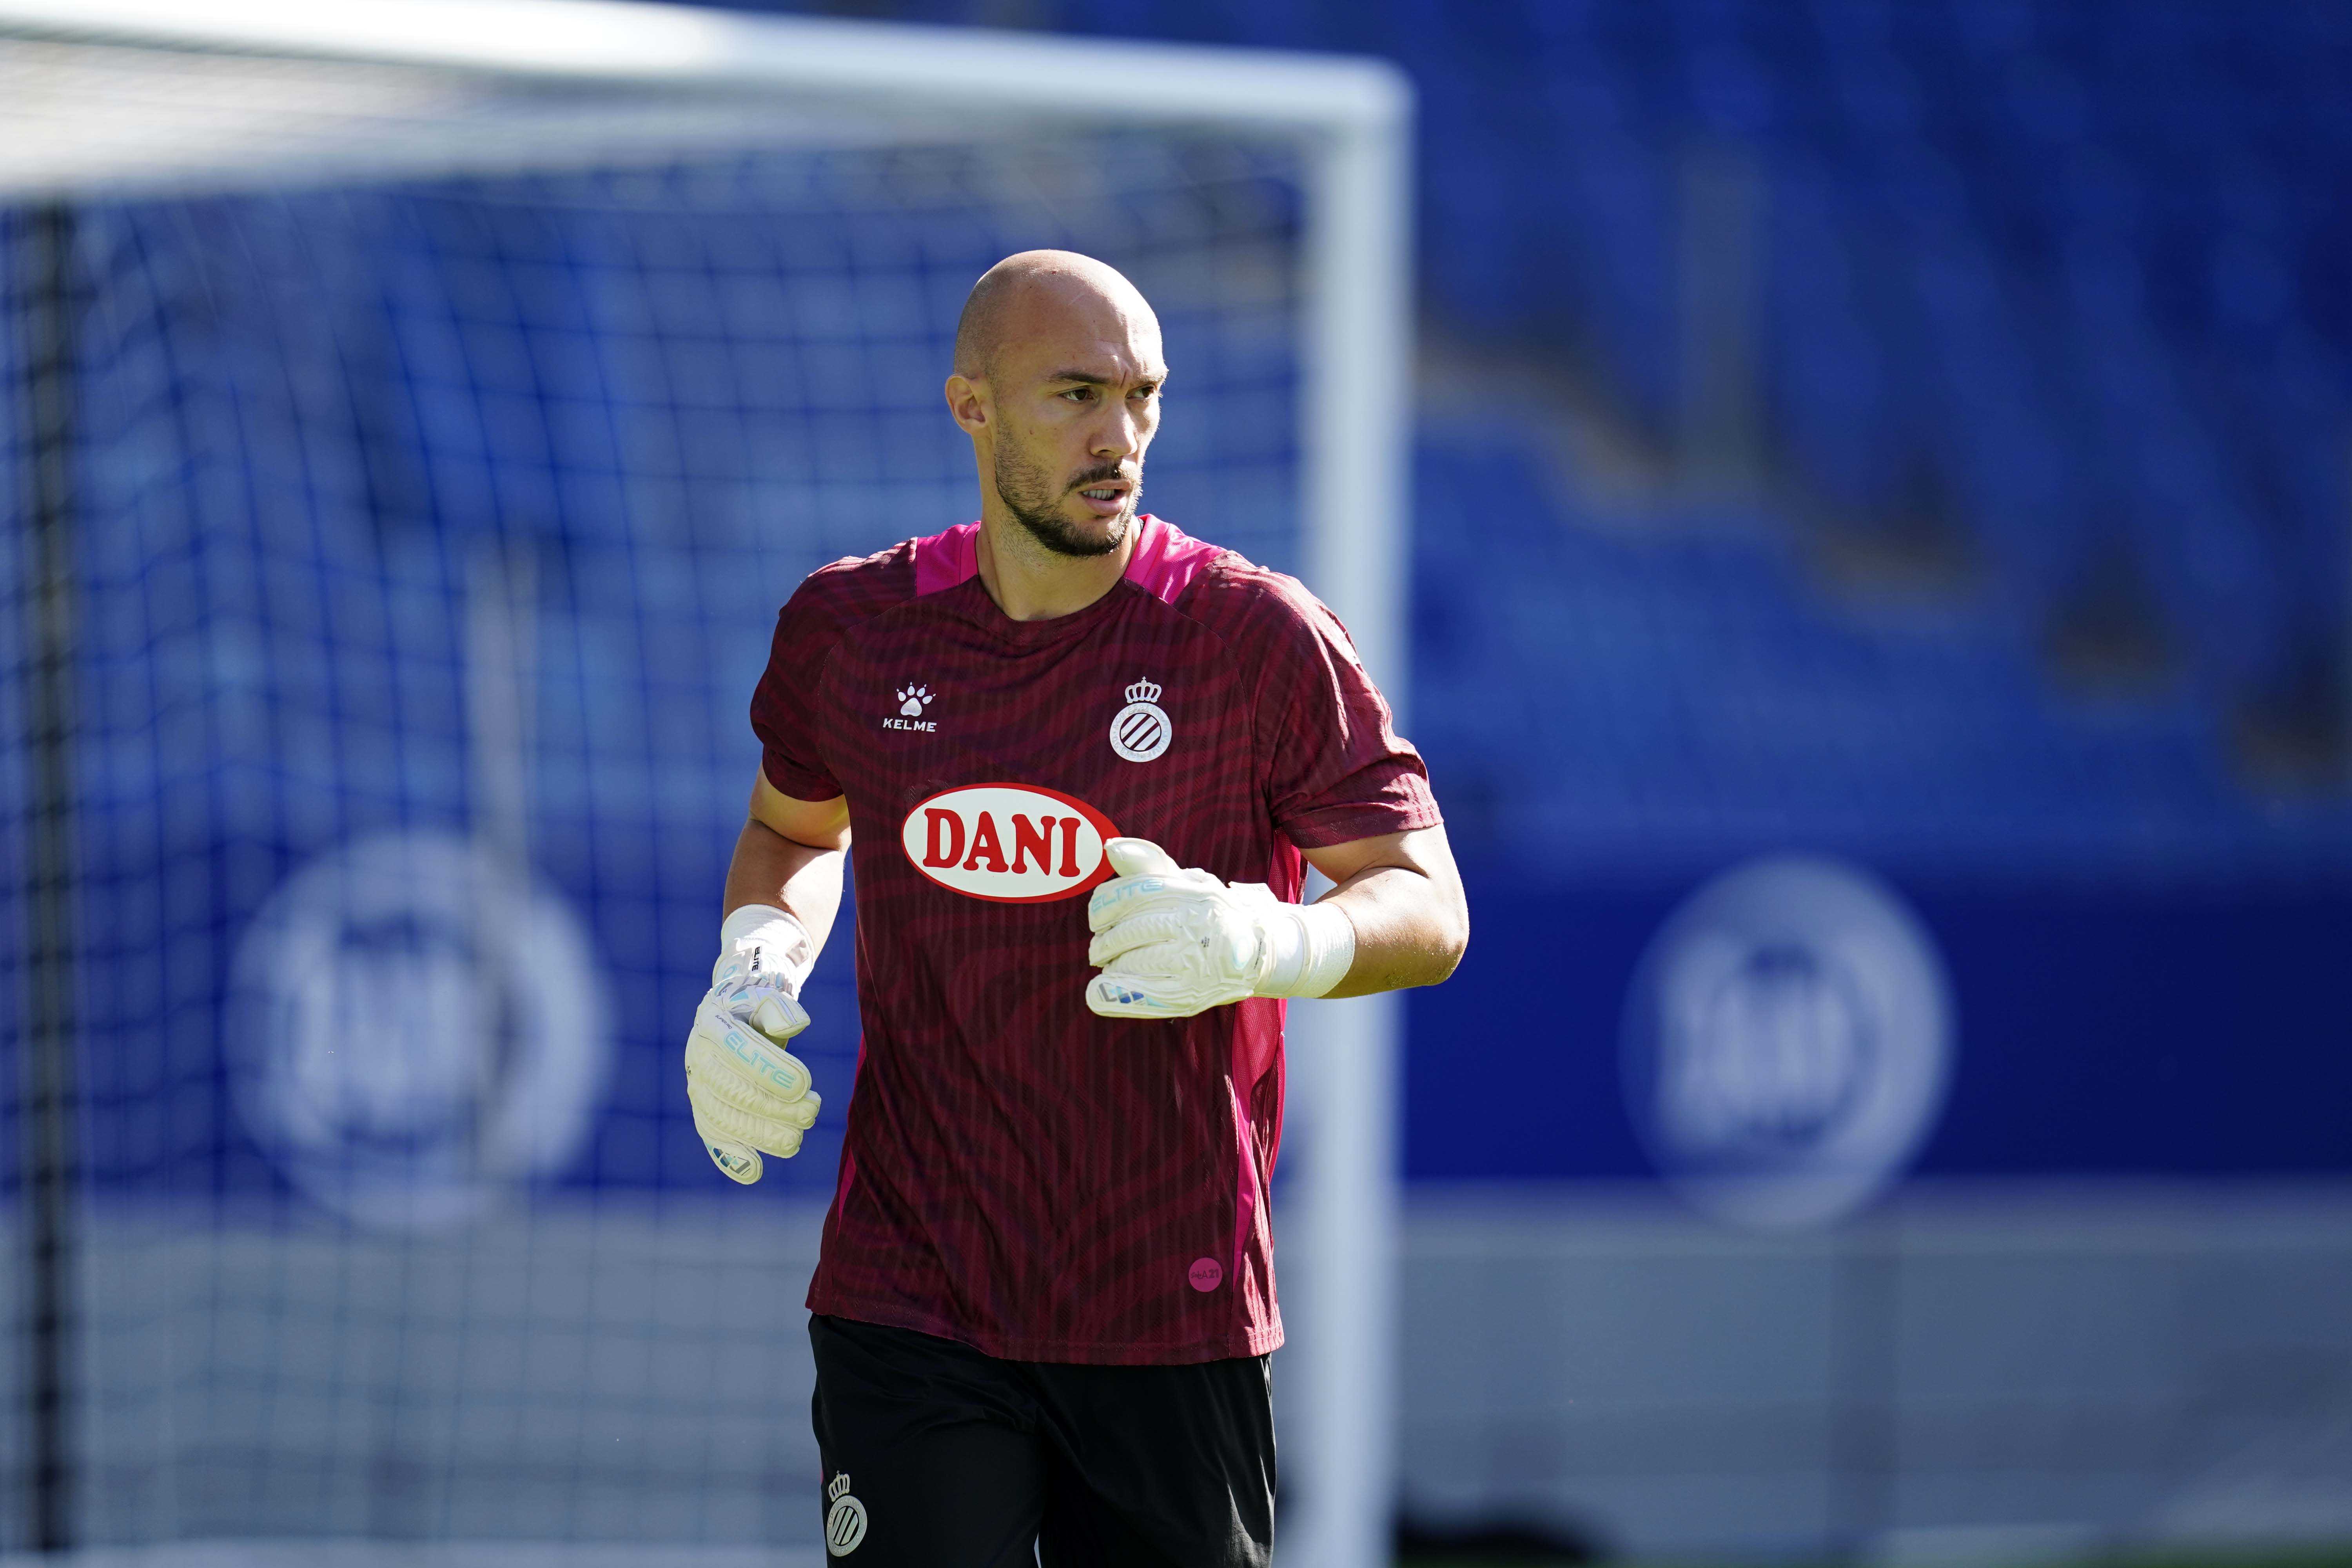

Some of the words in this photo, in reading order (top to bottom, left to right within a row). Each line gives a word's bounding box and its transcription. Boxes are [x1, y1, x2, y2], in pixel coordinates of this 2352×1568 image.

[883, 718, 937, 732] KELME
[923, 808, 1081, 877] DANI
[1091, 879, 1165, 913] ELITE
[751, 946, 761, 971] ELITE
[724, 1031, 796, 1089] ELITE
